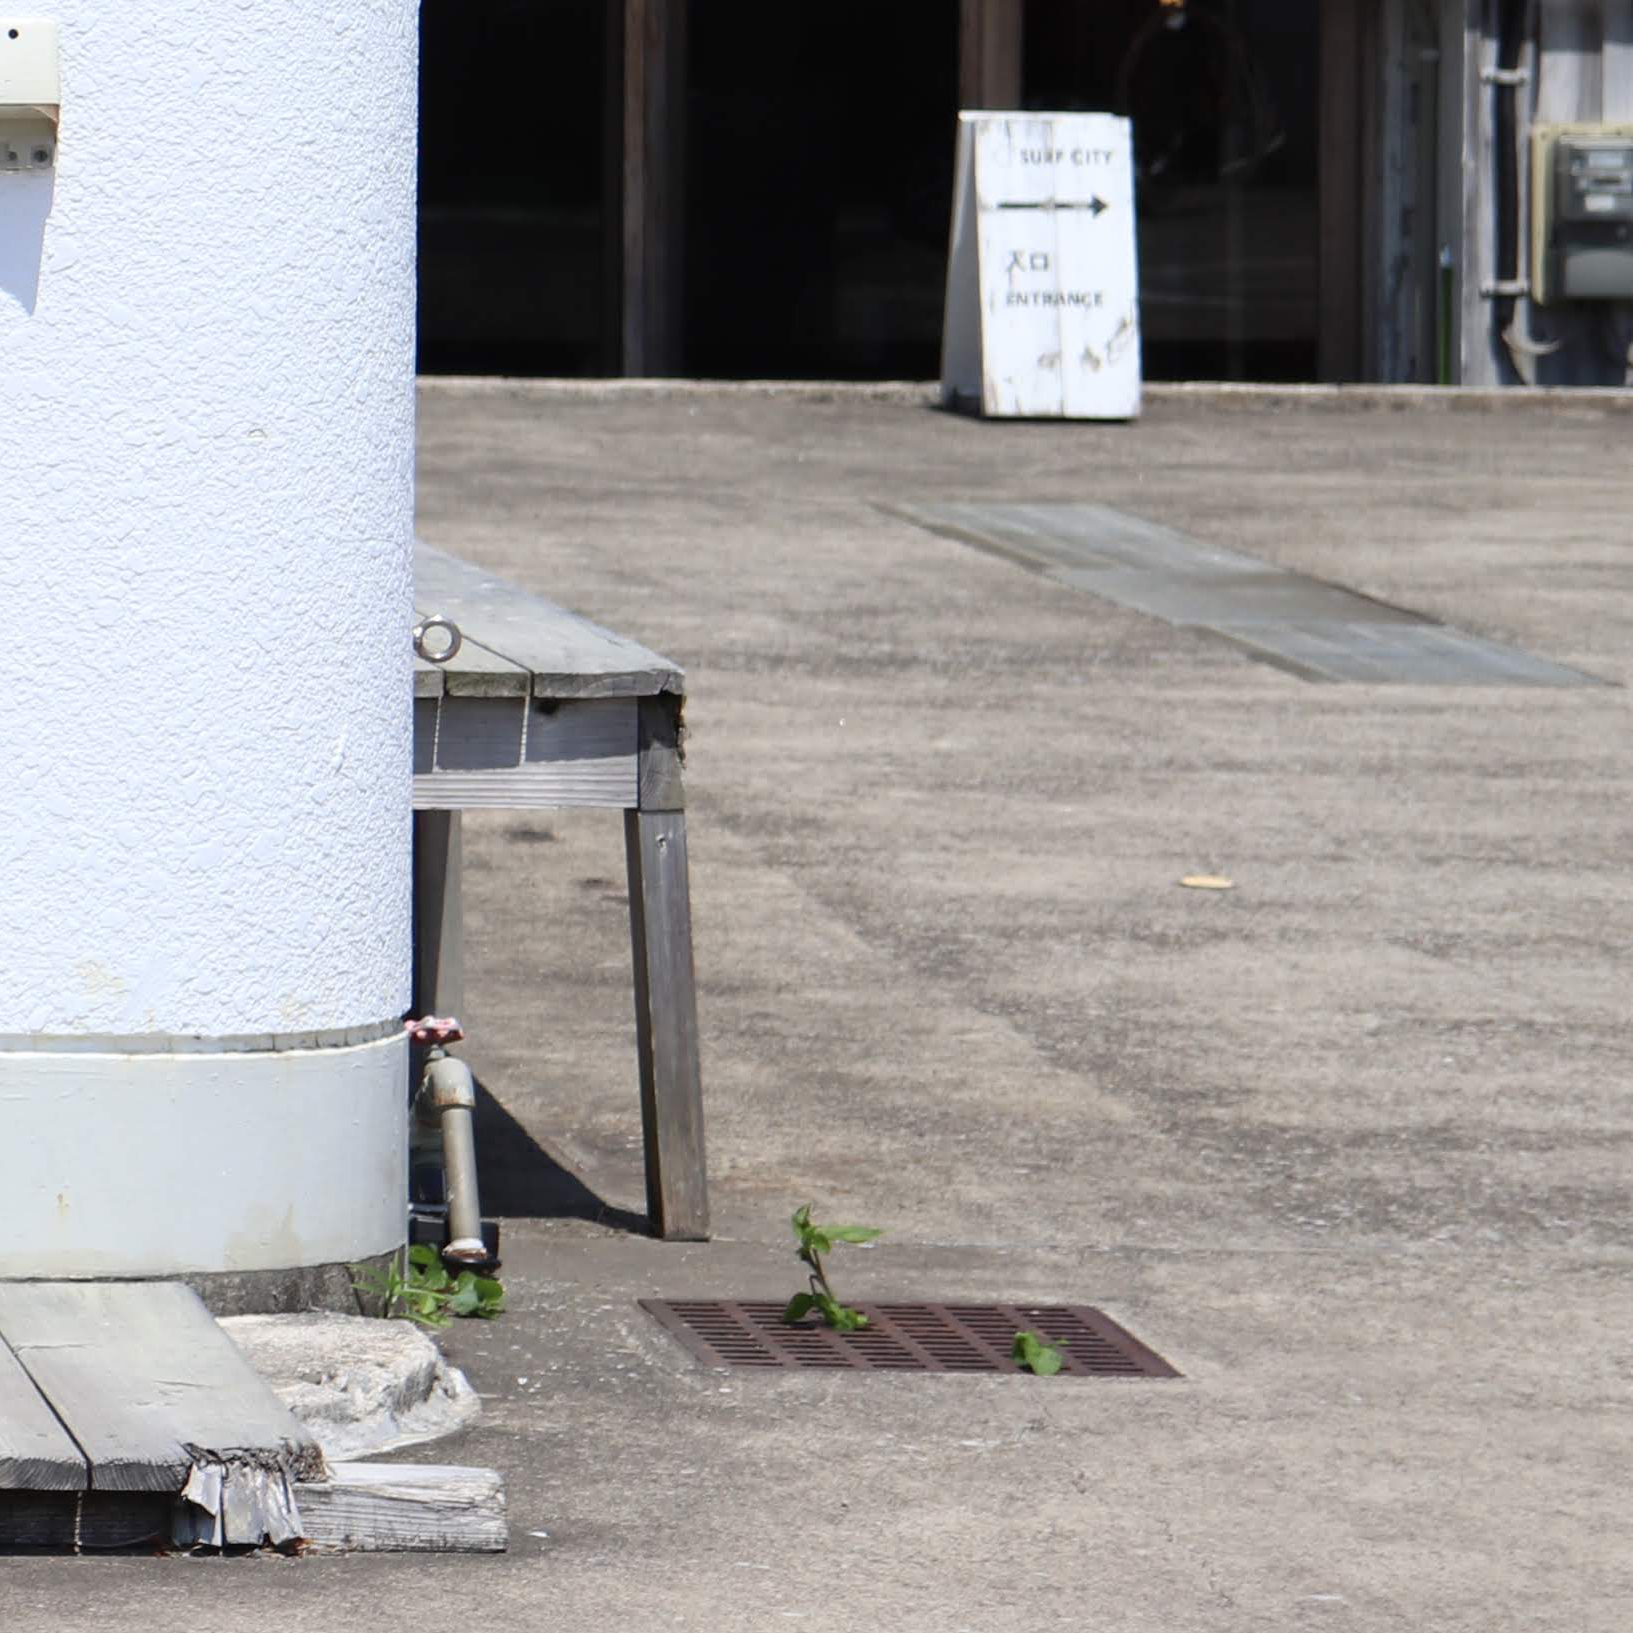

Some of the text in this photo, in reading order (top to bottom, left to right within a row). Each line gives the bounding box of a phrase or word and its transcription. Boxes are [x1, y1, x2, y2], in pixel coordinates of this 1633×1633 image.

[1021, 149, 1113, 165] SURF CITY
[1007, 291, 1104, 307] ENTRANCE
